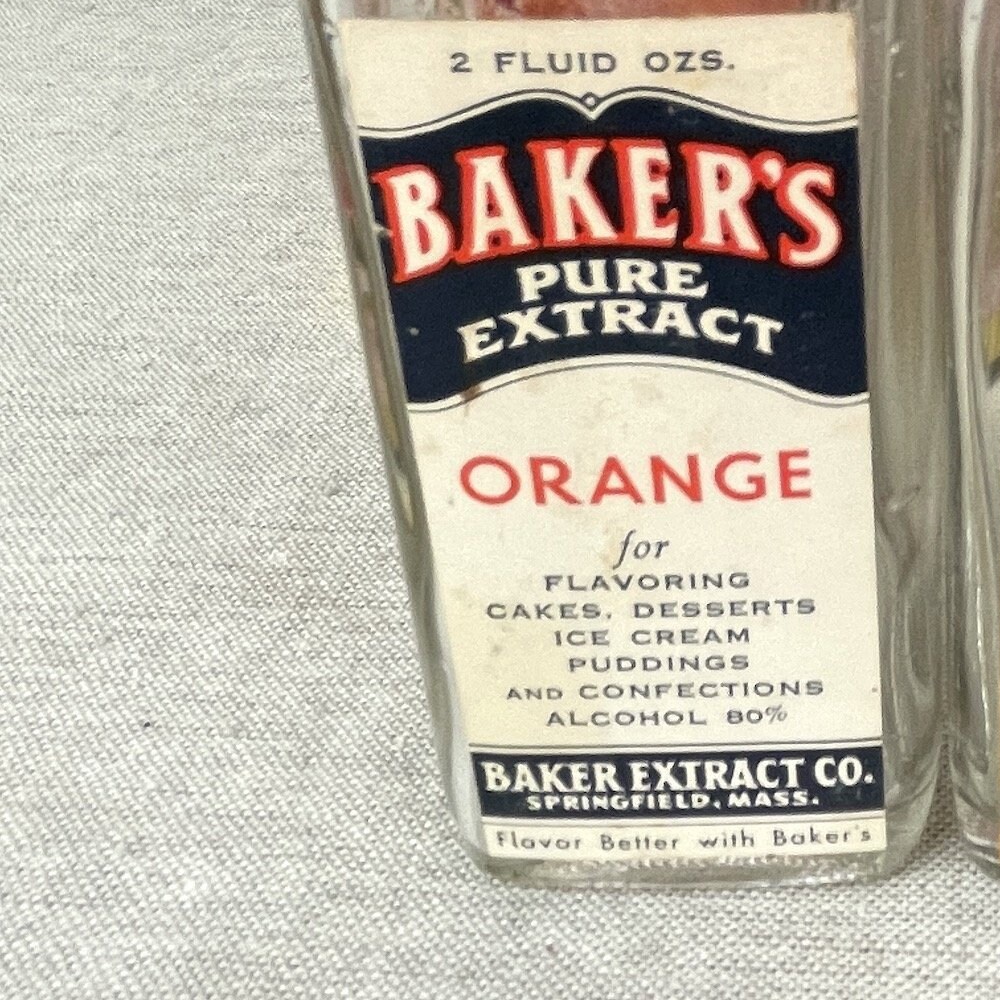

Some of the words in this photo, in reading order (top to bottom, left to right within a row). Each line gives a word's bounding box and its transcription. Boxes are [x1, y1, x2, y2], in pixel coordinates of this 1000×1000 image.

[450, 51, 472, 73] 2
[495, 51, 617, 74] FLUID
[645, 49, 736, 73] OZS.
[373, 137, 843, 283] BAKER'S
[516, 258, 710, 302] PURE
[457, 299, 784, 365] EXTRACT
[460, 448, 812, 505] ORANGE
[612, 530, 669, 570] for
[544, 571, 751, 592] FLAVORING
[486, 602, 613, 621] CAKES,
[633, 598, 816, 619] DESSERTS
[554, 630, 610, 646] ICE
[631, 627, 750, 645] CREAM
[568, 655, 750, 673] PUDDINGS
[506, 687, 563, 700] AND
[579, 680, 824, 699] CONFECTIONS
[546, 709, 707, 727] ALCOHOL
[726, 705, 787, 725] 80%
[480, 760, 621, 793] BAKER
[629, 757, 805, 790] EXTRACT
[814, 756, 874, 787] CO.
[727, 790, 819, 808] MASS.
[495, 831, 581, 850] Flavor
[600, 833, 678, 851] Better
[699, 830, 754, 848] with
[773, 825, 871, 847] Baker's
